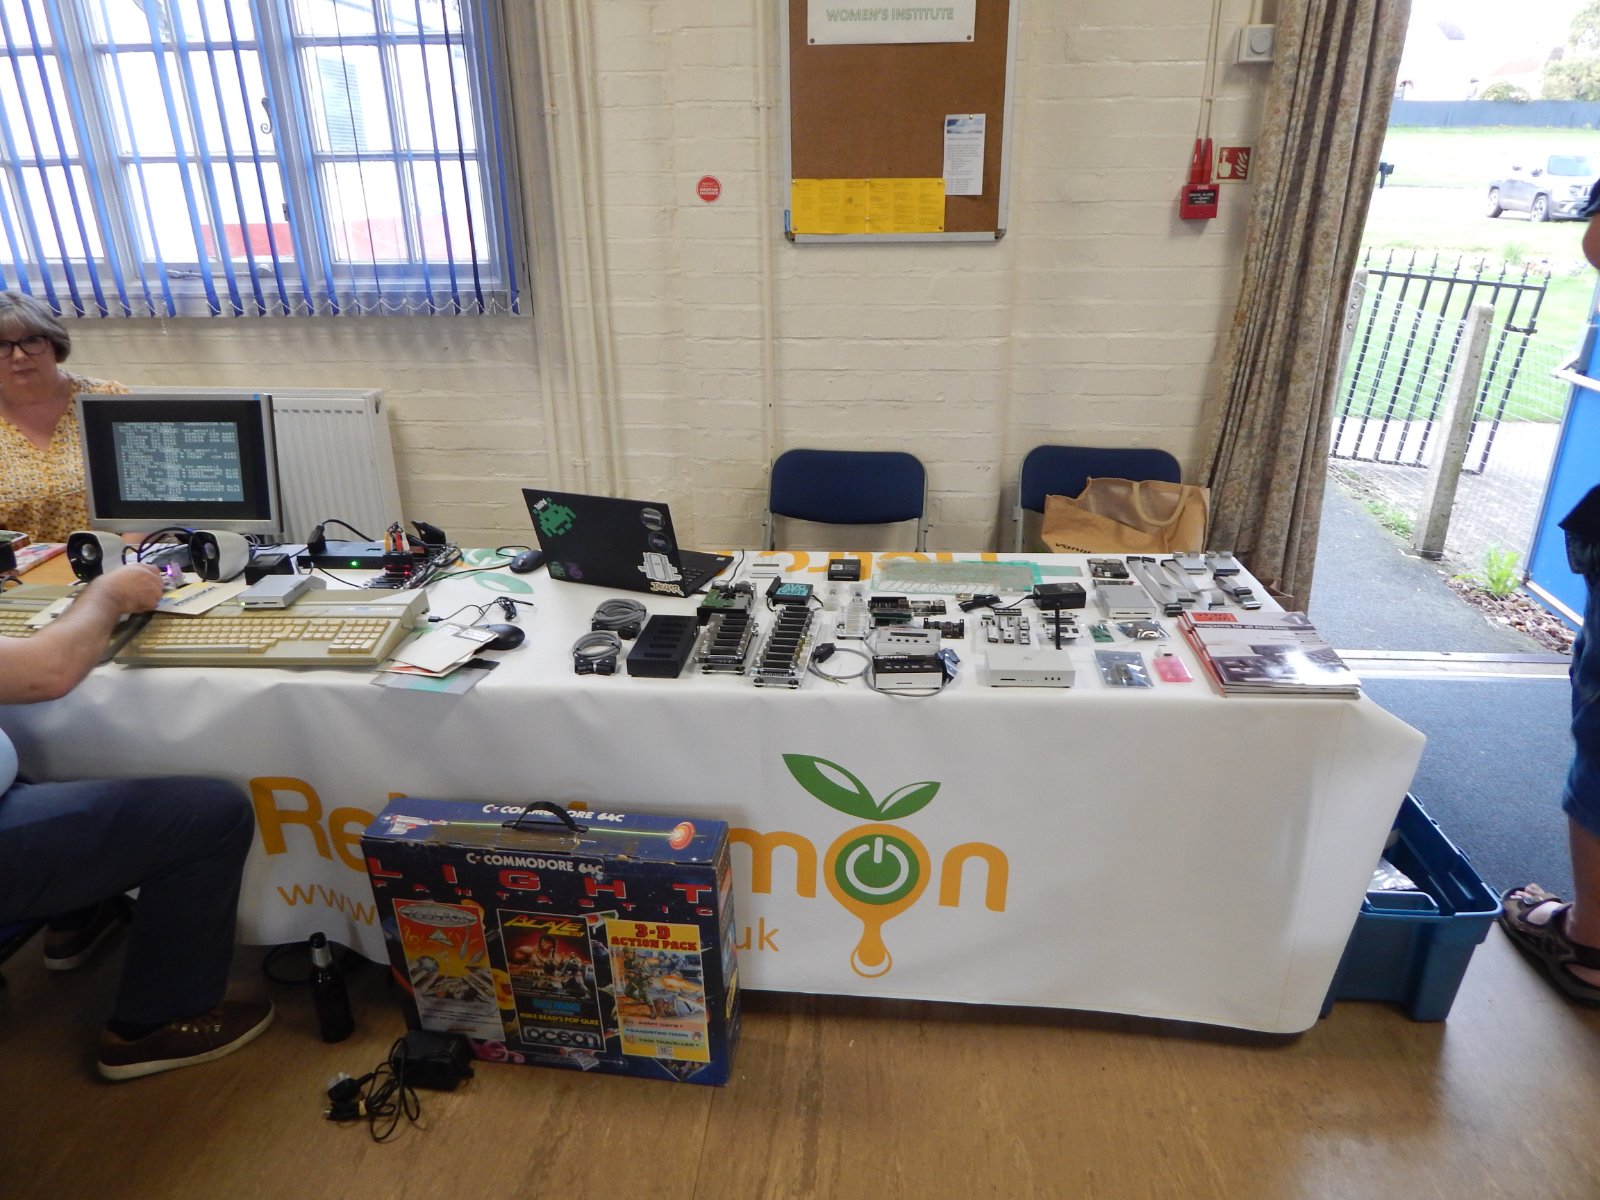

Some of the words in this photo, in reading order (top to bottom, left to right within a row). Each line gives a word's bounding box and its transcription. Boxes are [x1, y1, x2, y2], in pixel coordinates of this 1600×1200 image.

[825, 8, 888, 22] WOMEN'S
[891, 7, 954, 20] INSTITUTE
[597, 812, 625, 822] 64C
[484, 854, 574, 872] COMMODORE
[578, 863, 603, 874] 64C
[635, 923, 670, 940] 3-D
[611, 936, 660, 948] ACTION
[662, 940, 698, 951] PACK
[526, 1027, 600, 1047] ocean
